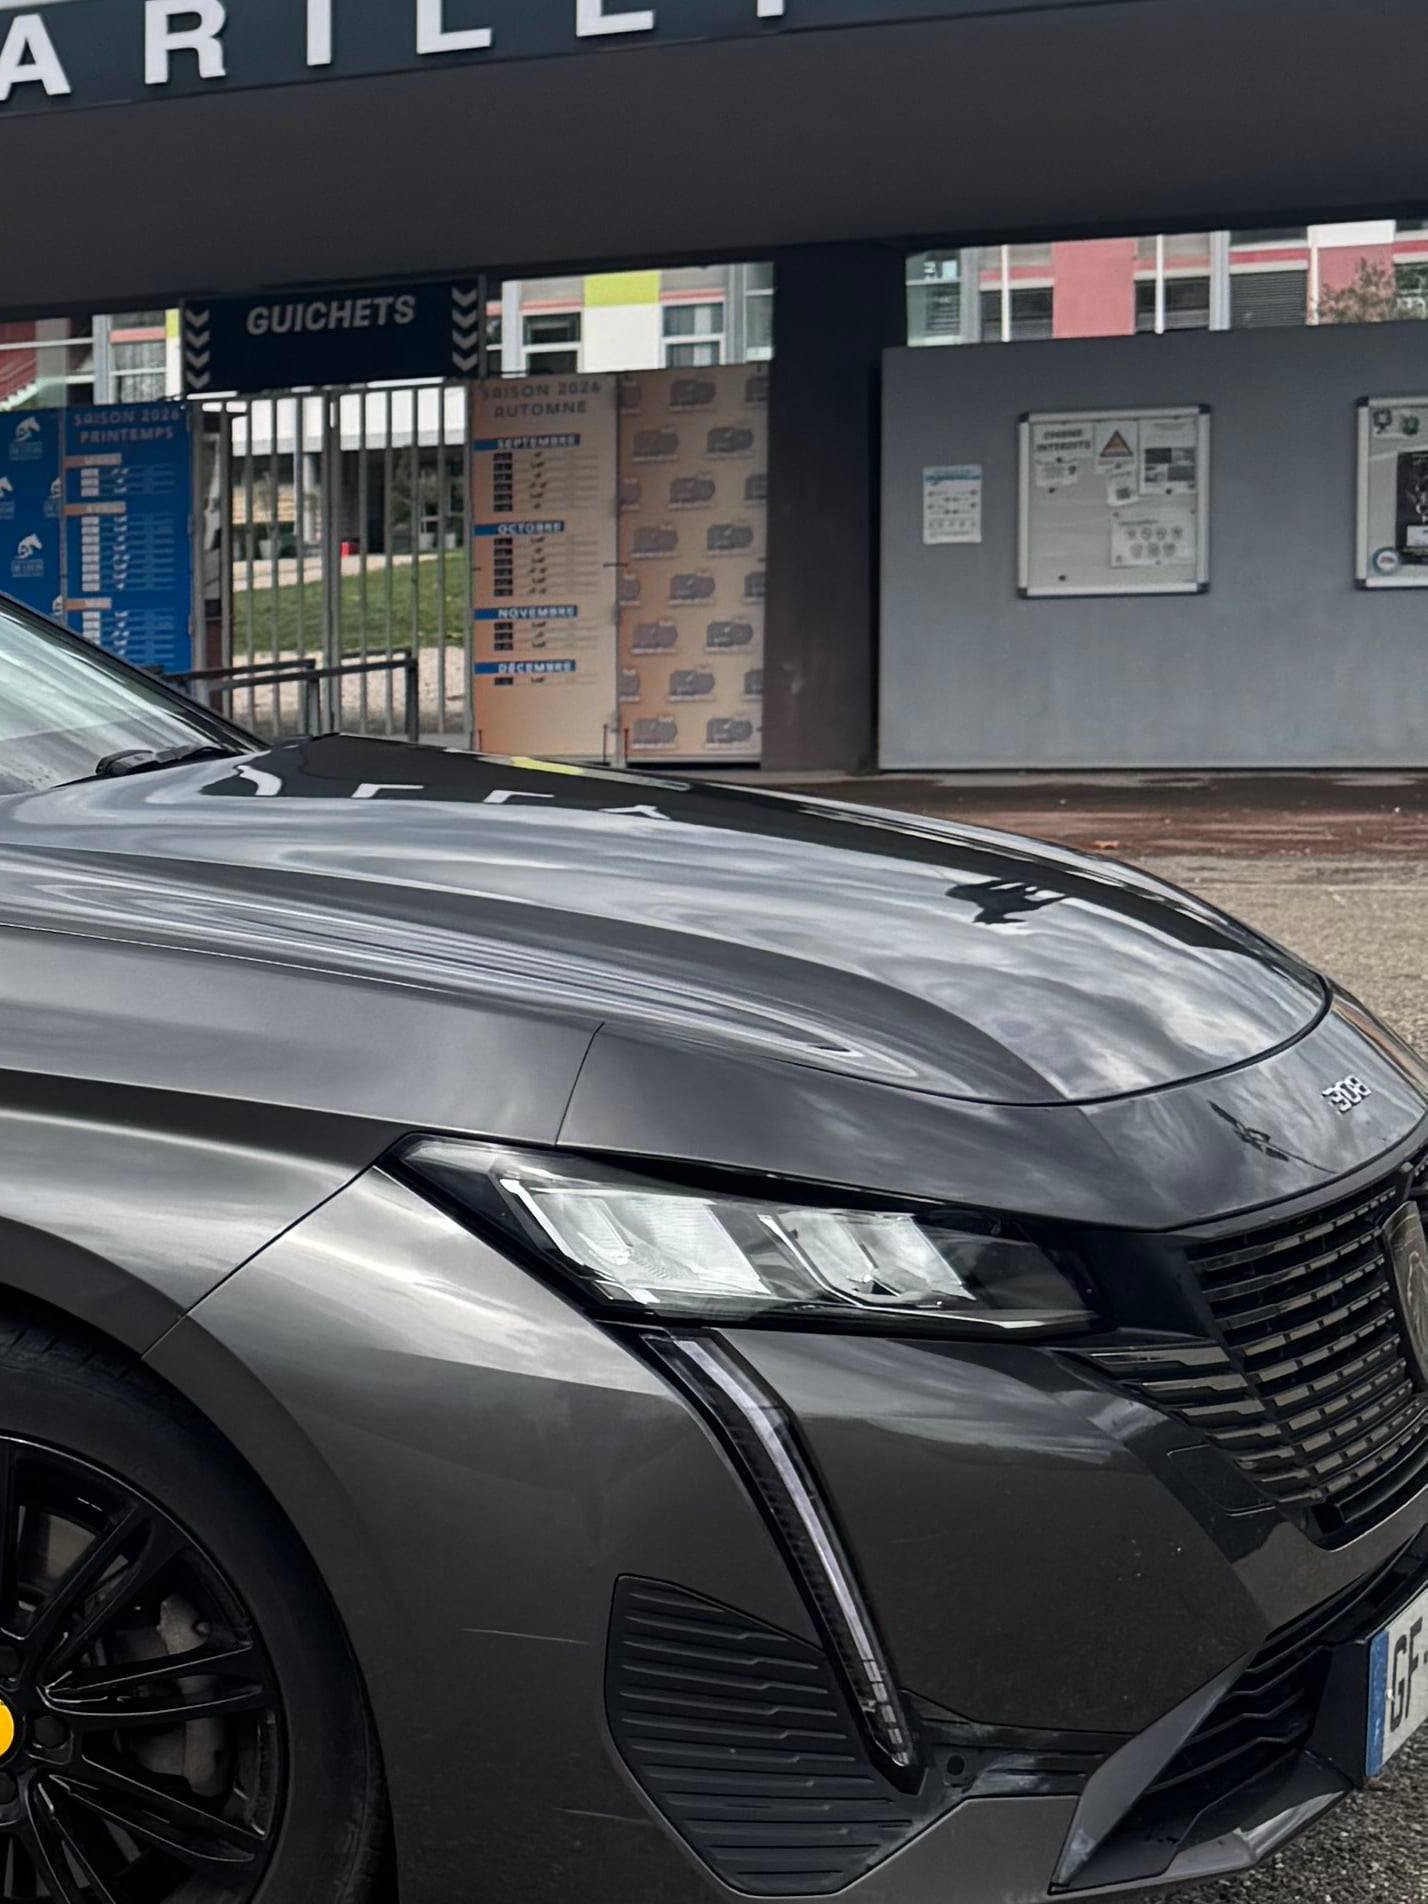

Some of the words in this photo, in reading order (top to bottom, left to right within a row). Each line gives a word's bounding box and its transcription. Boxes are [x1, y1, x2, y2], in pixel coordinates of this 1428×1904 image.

[245, 294, 417, 336] GUICHETS
[481, 382, 549, 400] SAISON
[494, 400, 587, 418] AUTOMNE
[73, 410, 135, 427] SAISON
[80, 426, 175, 444] PRINTEMPS
[497, 434, 576, 449] SEPTEMBRE
[497, 521, 562, 535] OCTOBRE
[497, 606, 574, 619] NOVEMBRE
[1321, 1075, 1372, 1113] 308
